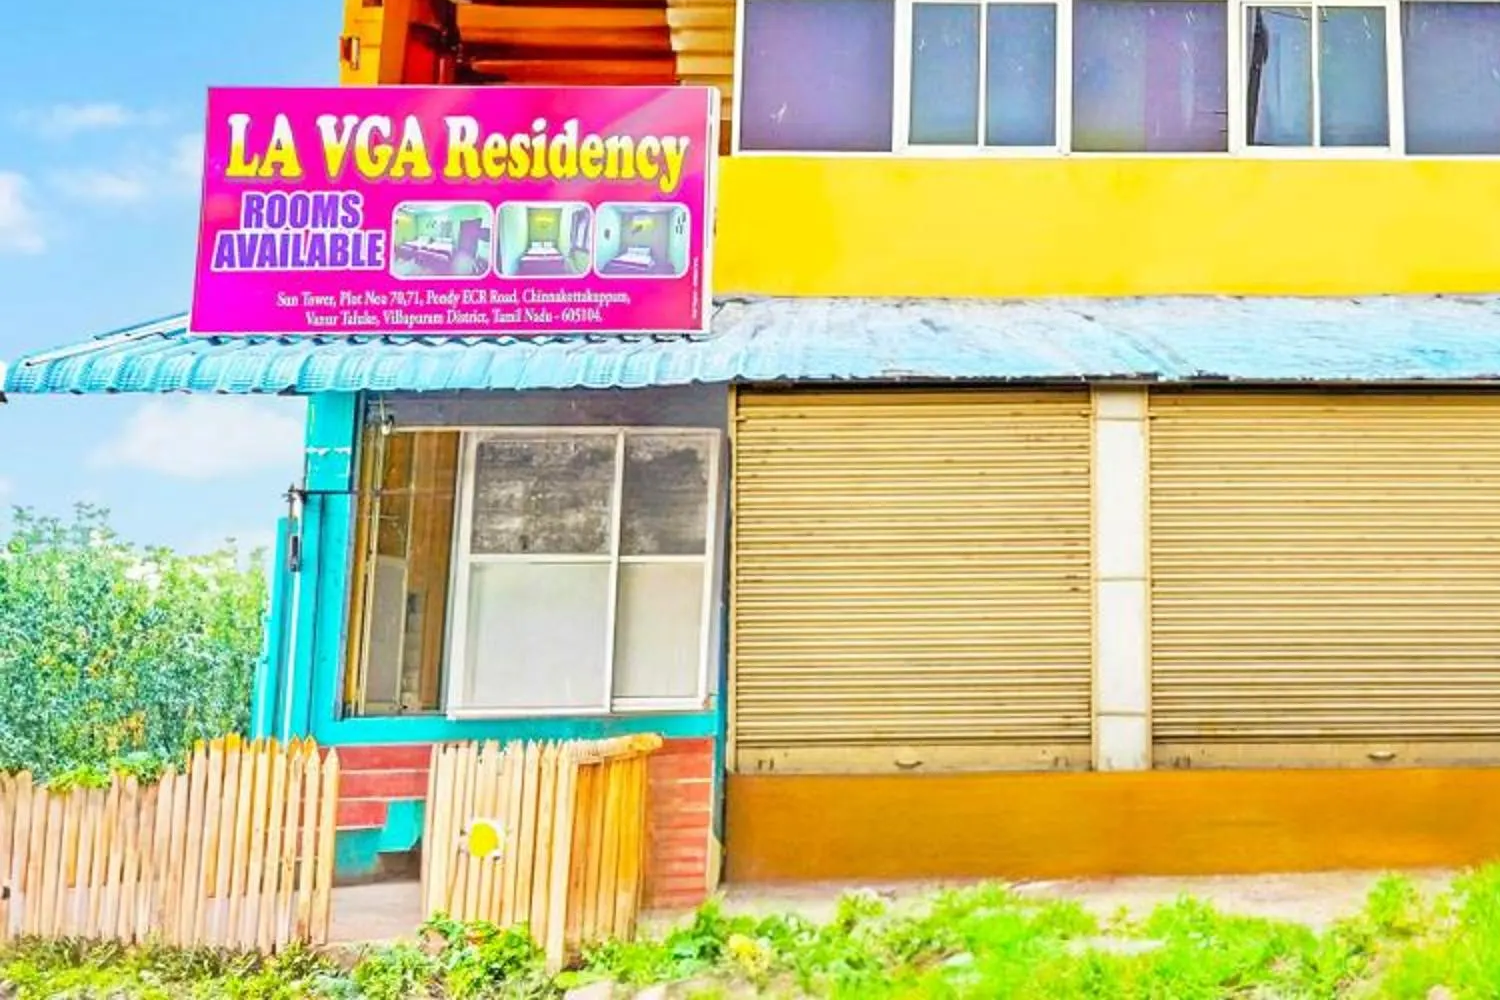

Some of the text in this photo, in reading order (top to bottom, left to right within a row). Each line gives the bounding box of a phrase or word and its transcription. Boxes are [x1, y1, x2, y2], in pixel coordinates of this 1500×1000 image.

[225, 112, 692, 193] LA VGA Residency
[243, 192, 362, 229] ROOMS
[213, 231, 384, 269] AVAILABLE
[276, 291, 299, 307] Sun
[339, 290, 362, 305] Plot
[462, 289, 487, 304] ECR
[492, 307, 522, 323] Tamil
[524, 307, 552, 323] Nadu
